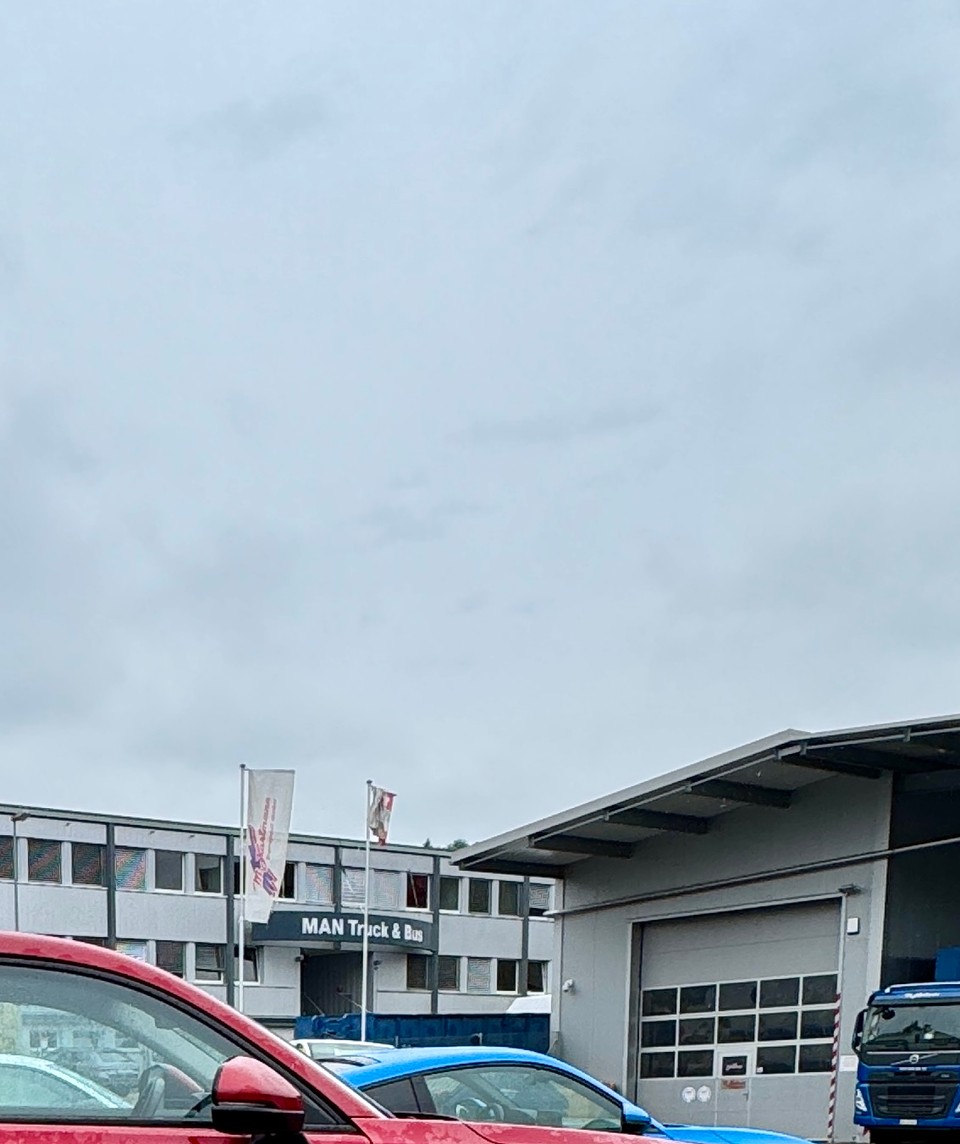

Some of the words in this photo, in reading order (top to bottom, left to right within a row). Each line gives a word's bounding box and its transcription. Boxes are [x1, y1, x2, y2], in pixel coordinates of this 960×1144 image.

[301, 917, 344, 936] MAN
[391, 922, 401, 939] &
[404, 923, 424, 942] Bus
